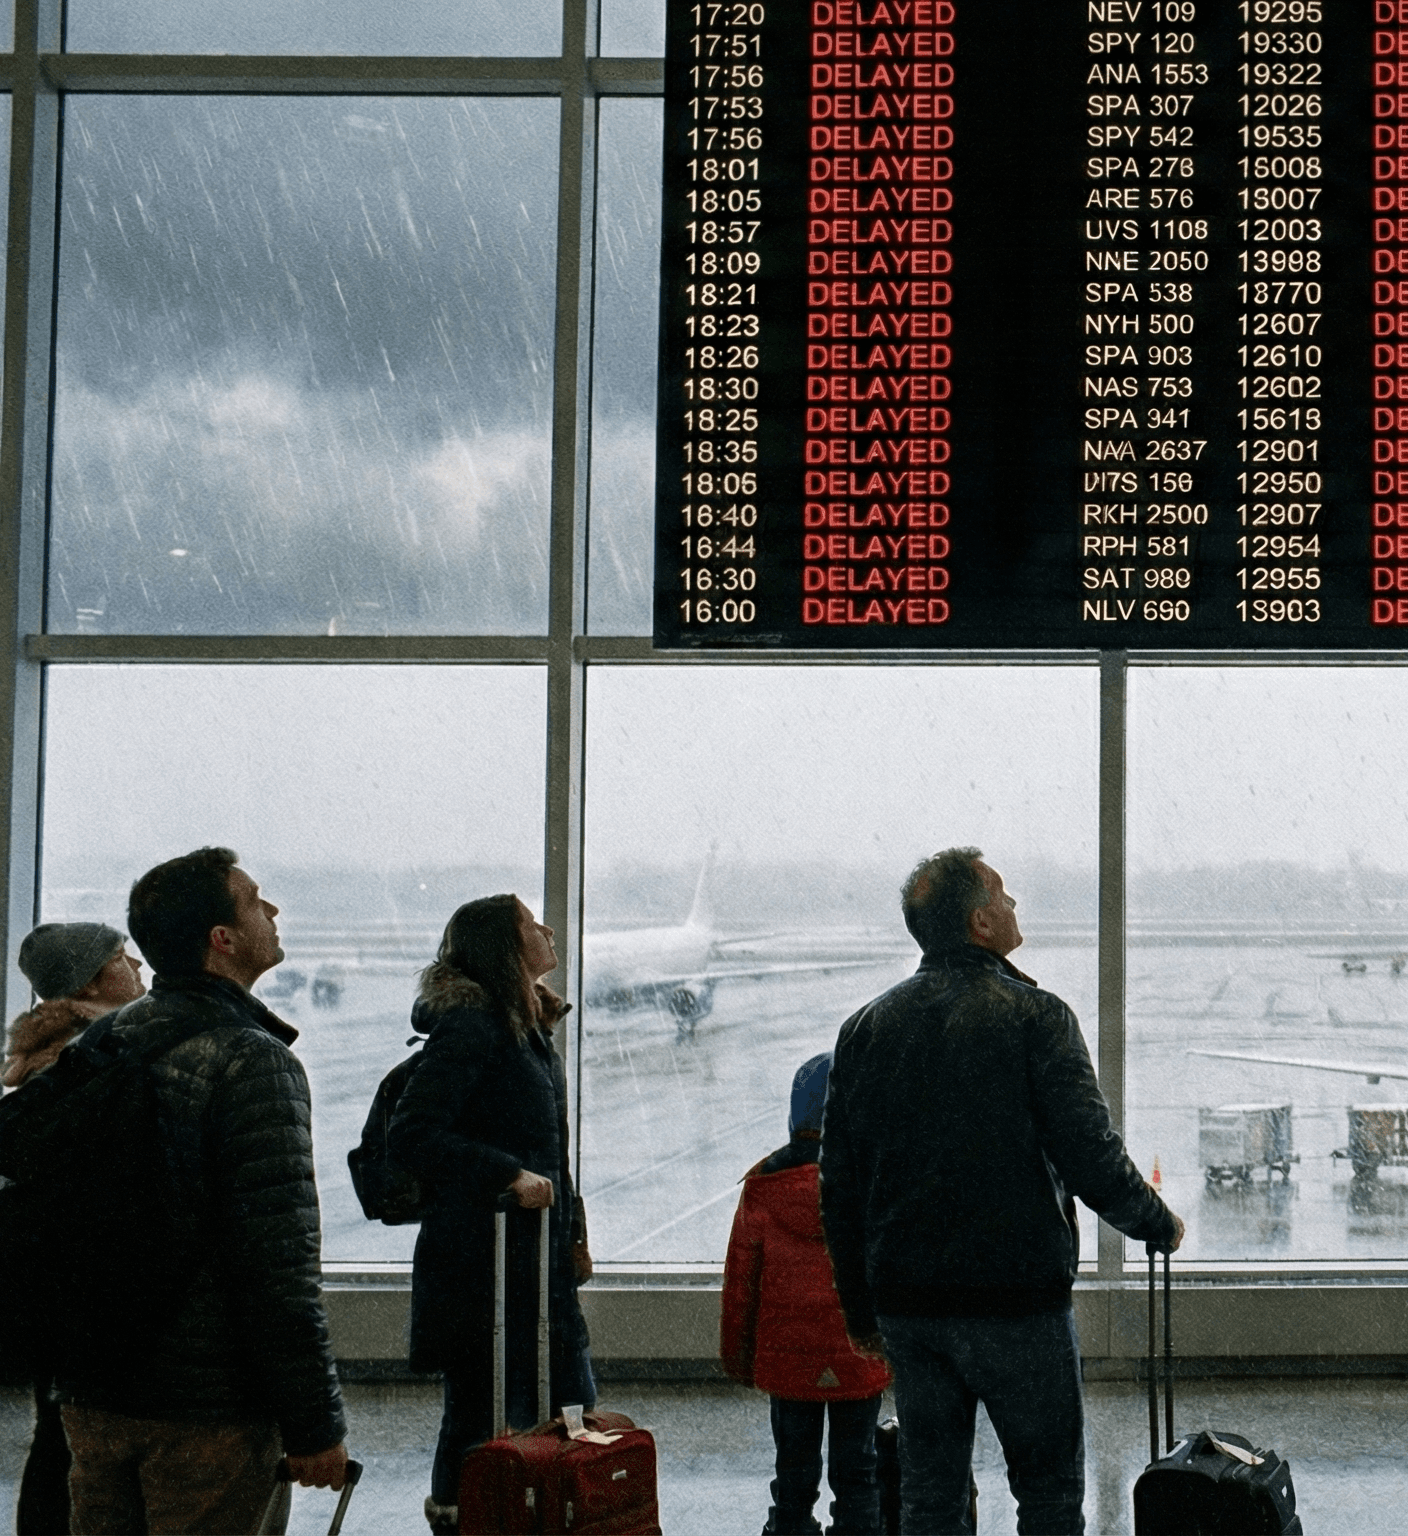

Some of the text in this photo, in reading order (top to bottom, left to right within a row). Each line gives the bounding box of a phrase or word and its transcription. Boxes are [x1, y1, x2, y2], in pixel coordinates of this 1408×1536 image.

[690, 3, 765, 26] 17:20
[813, 0, 956, 26] DELAYED
[1088, 1, 1142, 22] NEV
[1151, 1, 1196, 22] 109
[1238, 0, 1323, 23] 19295
[690, 34, 760, 57] 17:51
[812, 32, 955, 57] DELAYED
[1088, 32, 1142, 54] SPY
[1151, 32, 1195, 54] 120
[1238, 31, 1322, 54] 19330
[689, 65, 764, 88] 17:56
[812, 63, 955, 88] DELAYED
[1086, 63, 1141, 85] ANA
[1151, 63, 1209, 85] 1553
[1237, 63, 1322, 85] 19322
[688, 96, 763, 119] 17:53
[811, 94, 954, 119] DELAYED
[1086, 94, 1141, 116] SPA
[1149, 94, 1194, 116] 307
[1238, 94, 1322, 117] 12026
[687, 127, 763, 150] 17:56
[810, 125, 954, 151] DELAYED
[1087, 125, 1141, 147] SPY
[1149, 125, 1194, 147] 542
[1238, 125, 1322, 148] 19535
[686, 158, 759, 181] 18:01
[810, 156, 954, 181] DELAYED
[1087, 157, 1140, 178] SPA
[686, 189, 762, 213] 18:05
[809, 187, 953, 213] DELAYED
[1085, 188, 1140, 209] ARE
[1149, 188, 1194, 209] 576
[685, 220, 761, 244] 18:57
[808, 219, 953, 244] DELAYED
[1086, 219, 1139, 240] UVS
[1150, 219, 1208, 240] 1108
[1238, 218, 1322, 241] 12003
[685, 251, 761, 275] 18:09
[808, 249, 952, 275] DELAYED
[1086, 250, 1139, 271] NNE
[1148, 250, 1209, 271] 2050
[685, 282, 756, 306] 18:21
[808, 281, 952, 307] DELAYED
[1085, 282, 1139, 303] SPA
[1149, 282, 1193, 303] 538
[1237, 281, 1322, 305] 18770
[685, 314, 760, 337] 18:23
[808, 312, 952, 338] DELAYED
[1085, 313, 1139, 334] NYH
[1148, 313, 1194, 334] 500
[1238, 313, 1322, 336] 12607
[685, 345, 759, 369] 18:26
[807, 343, 951, 369] DELAYED
[1085, 345, 1139, 366] SPA
[1148, 345, 1193, 366] 903
[1237, 344, 1322, 367] 12610
[684, 377, 759, 400] 18:30
[807, 375, 951, 401] DELAYED
[1085, 376, 1139, 398] NAS
[1147, 376, 1193, 398] 753
[1237, 375, 1322, 398] 12602
[684, 408, 759, 432] 18:25
[806, 407, 951, 432] DELAYED
[1084, 407, 1139, 429] SPA
[683, 440, 758, 463] 18:35
[805, 439, 951, 464] DELAYED
[1145, 440, 1208, 461] 2637
[1236, 439, 1318, 462] 12901
[805, 471, 950, 496] DELAYED
[1236, 471, 1322, 494] 12950
[681, 504, 758, 527] 16:40
[804, 502, 950, 527] DELAYED
[1146, 503, 1209, 525] 2500
[1236, 503, 1322, 526] 12907
[681, 535, 756, 559] 16:44
[804, 534, 950, 560] DELAYED
[1083, 535, 1137, 557] RPH
[1147, 535, 1189, 557] 581
[1236, 535, 1321, 558] 12954
[680, 567, 756, 591] 16:30
[803, 566, 949, 592] DELAYED
[1082, 567, 1136, 589] SAT
[1236, 567, 1321, 590] 12955
[680, 599, 756, 623] 16:00
[803, 597, 949, 624] DELAYED
[1083, 599, 1136, 621] NLV
